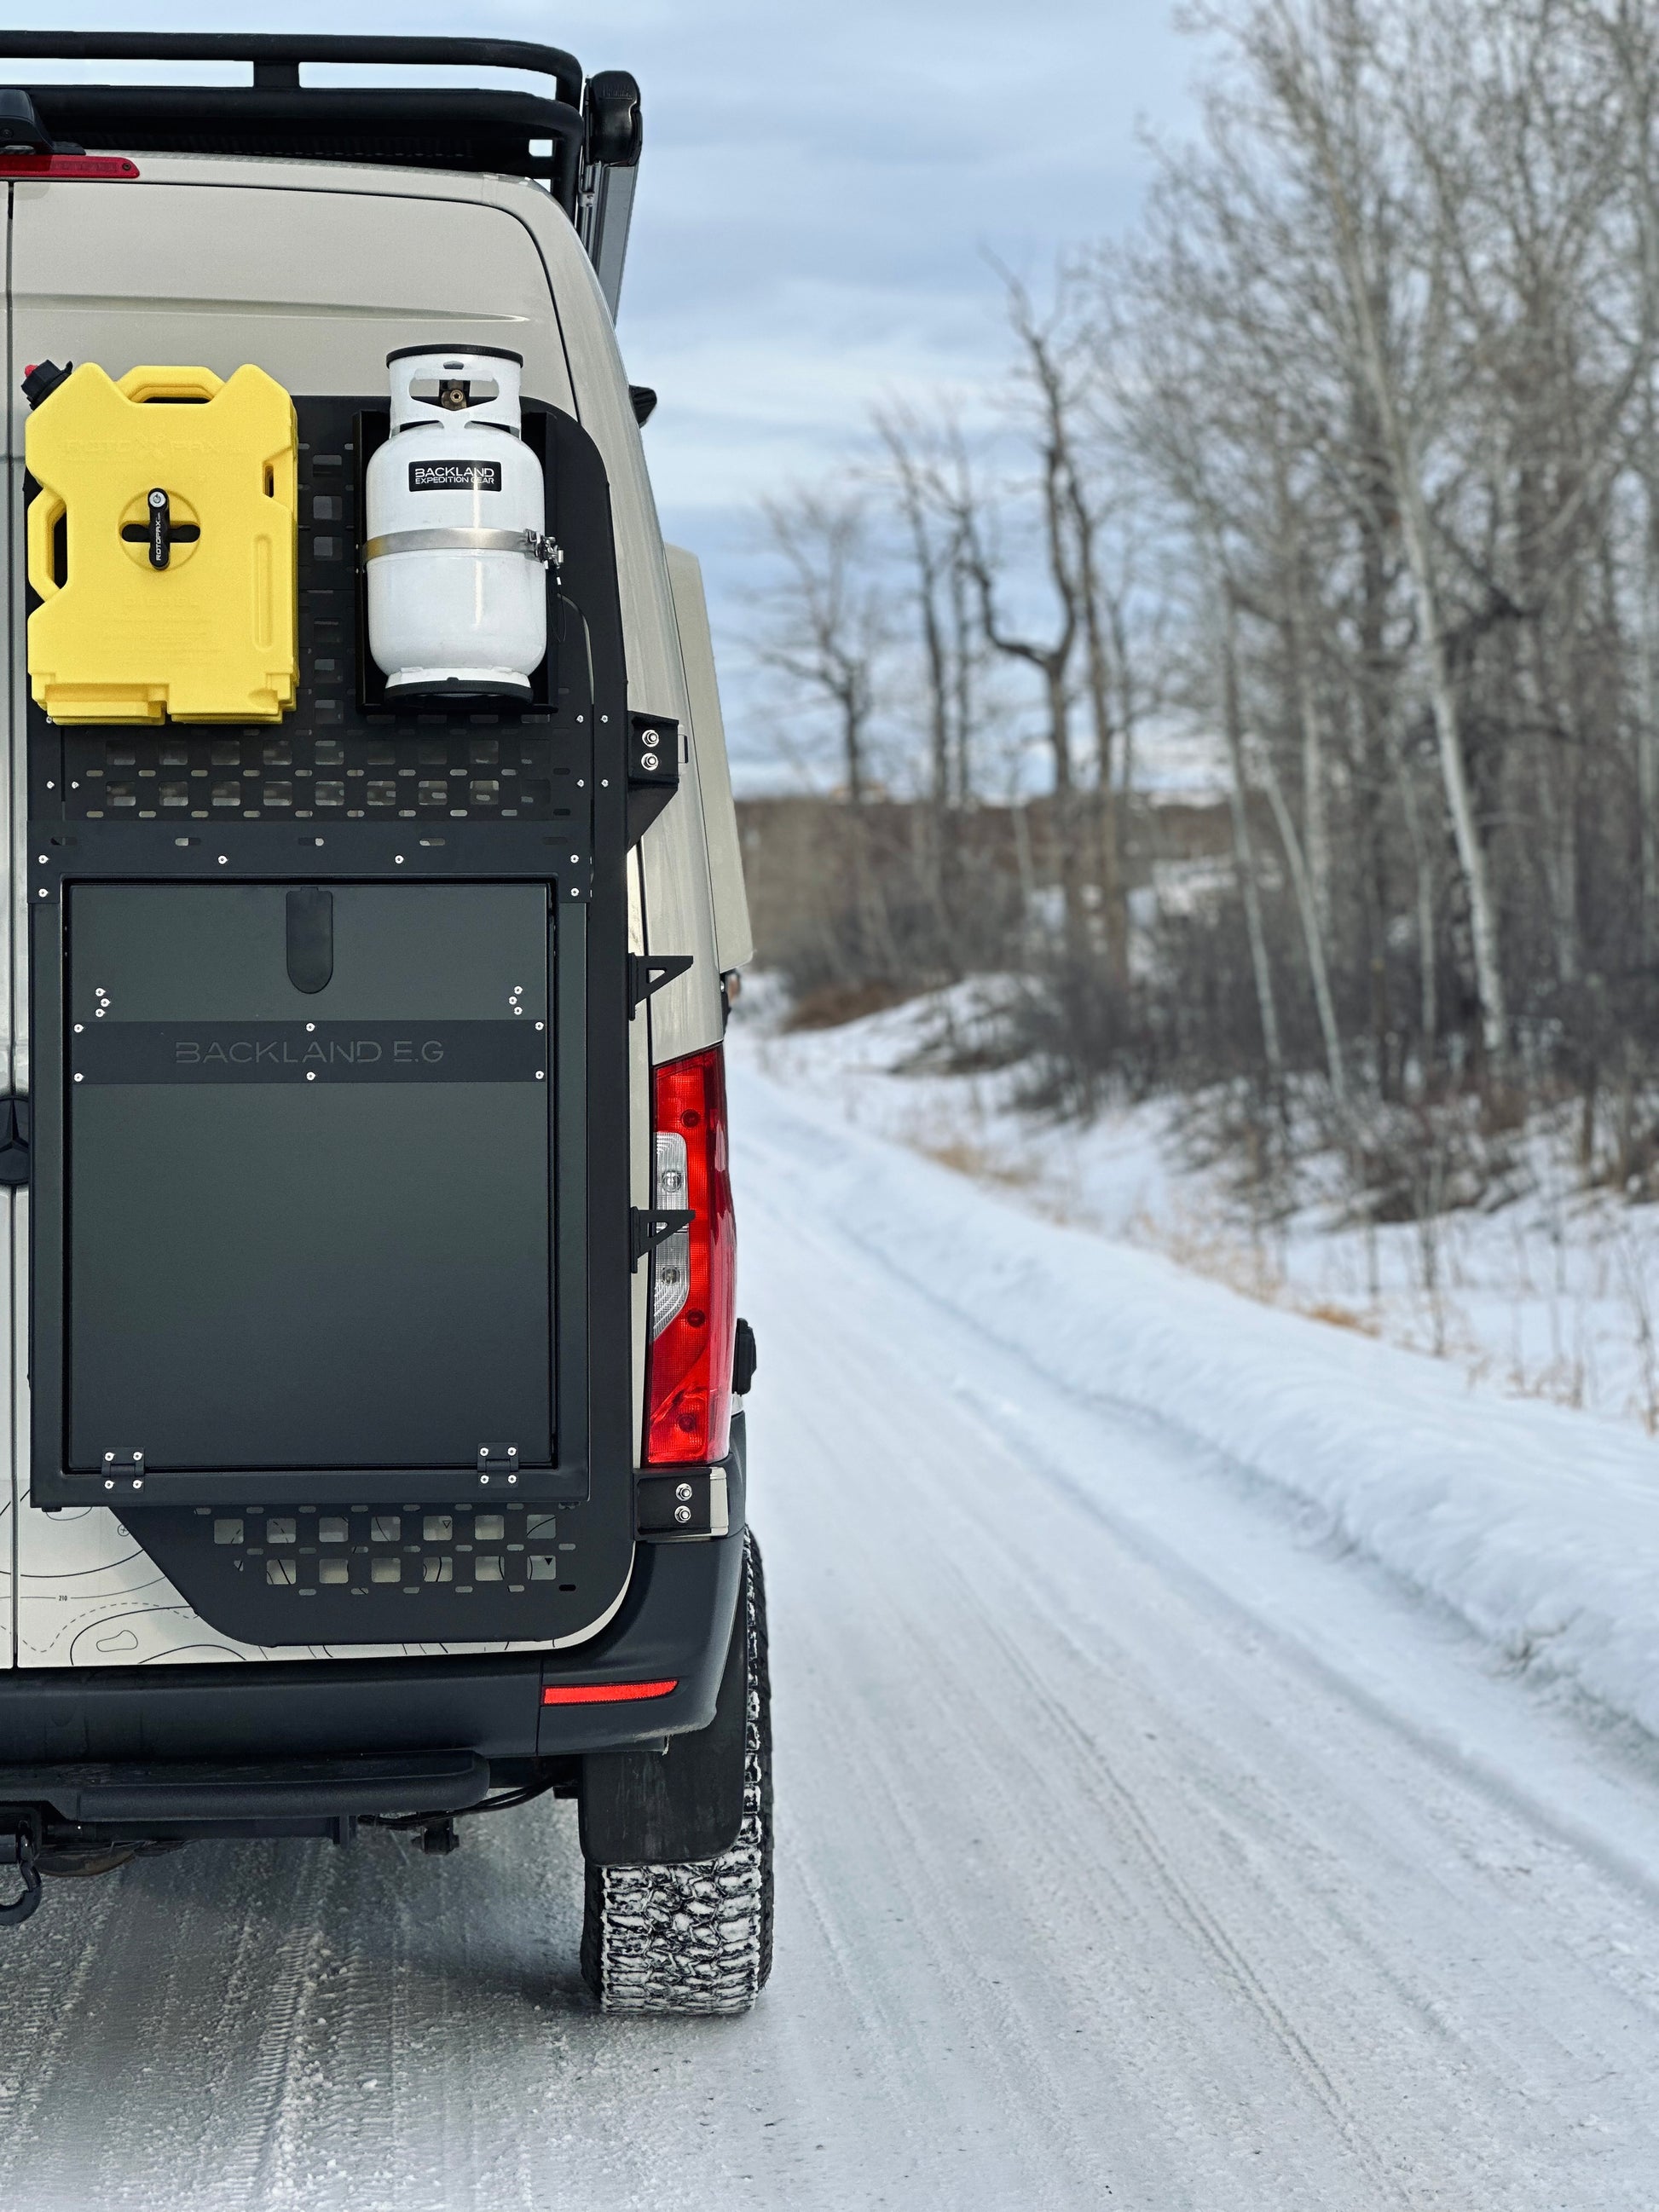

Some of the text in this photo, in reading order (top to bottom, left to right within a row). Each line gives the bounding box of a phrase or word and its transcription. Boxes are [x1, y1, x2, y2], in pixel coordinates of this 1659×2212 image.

[414, 467, 494, 478] BACKLAND
[415, 476, 494, 485] EXPEDITION GEAR
[175, 1040, 445, 1064] BACKLAND E.G
